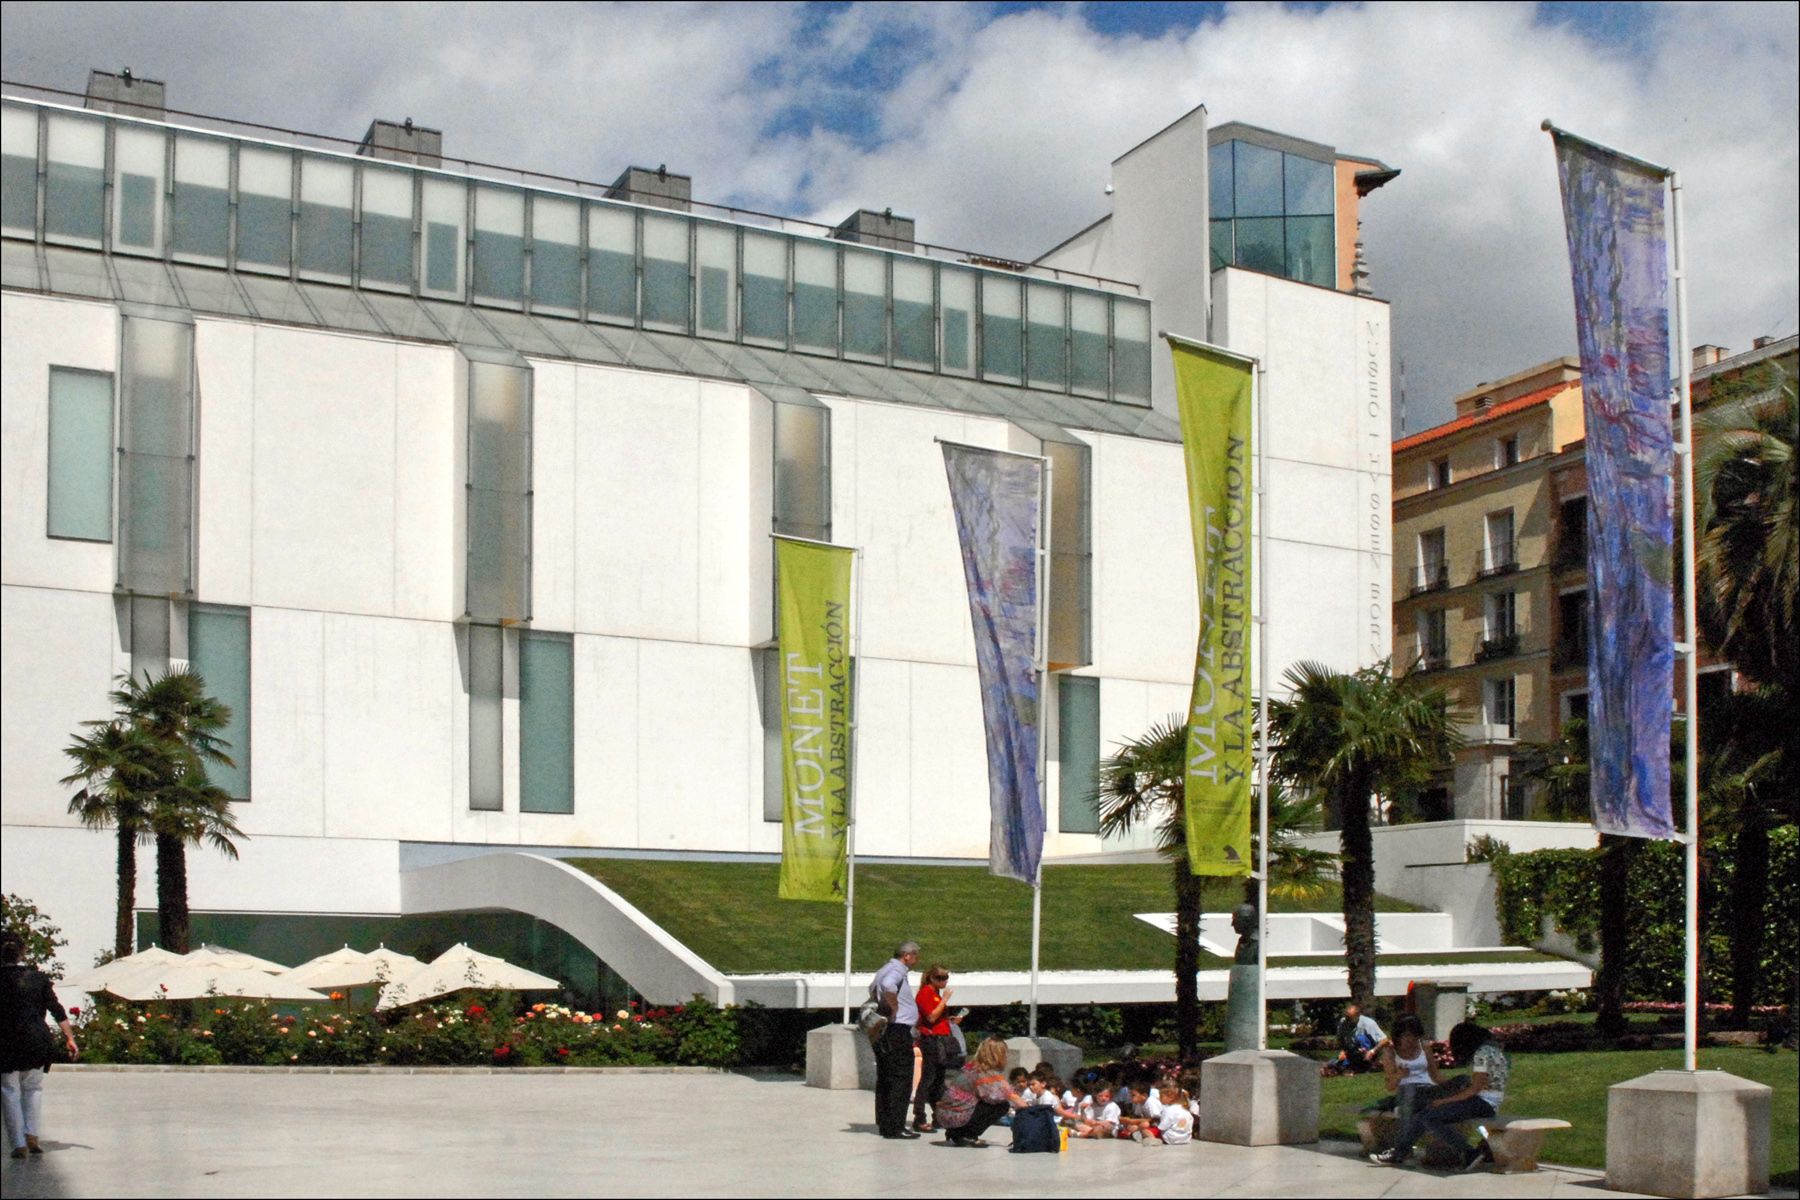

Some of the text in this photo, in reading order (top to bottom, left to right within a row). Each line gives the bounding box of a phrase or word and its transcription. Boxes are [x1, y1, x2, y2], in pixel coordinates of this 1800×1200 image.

[1223, 706, 1245, 753] LA
[786, 652, 825, 840] MONET
[1224, 760, 1245, 784] Y
[831, 786, 847, 817] LA
[832, 822, 847, 839] Y
